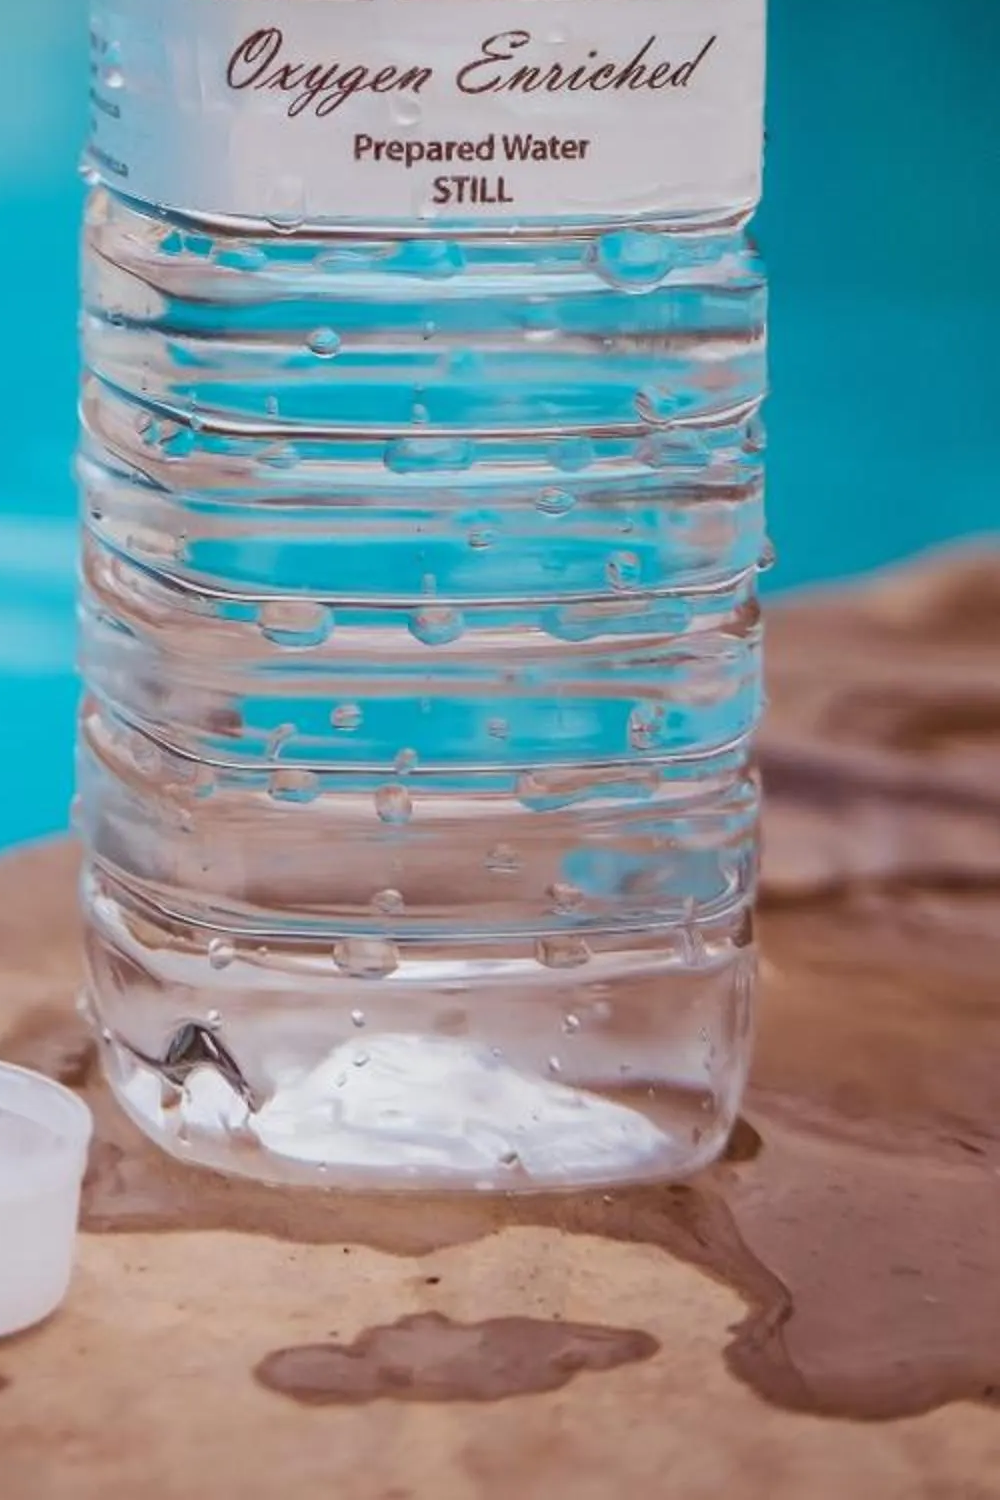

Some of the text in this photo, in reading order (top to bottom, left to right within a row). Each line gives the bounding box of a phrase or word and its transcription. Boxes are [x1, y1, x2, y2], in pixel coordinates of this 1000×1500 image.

[227, 28, 716, 116] Oxygen Enriched
[354, 133, 590, 166] Prepared Water
[432, 176, 514, 204] STILL
